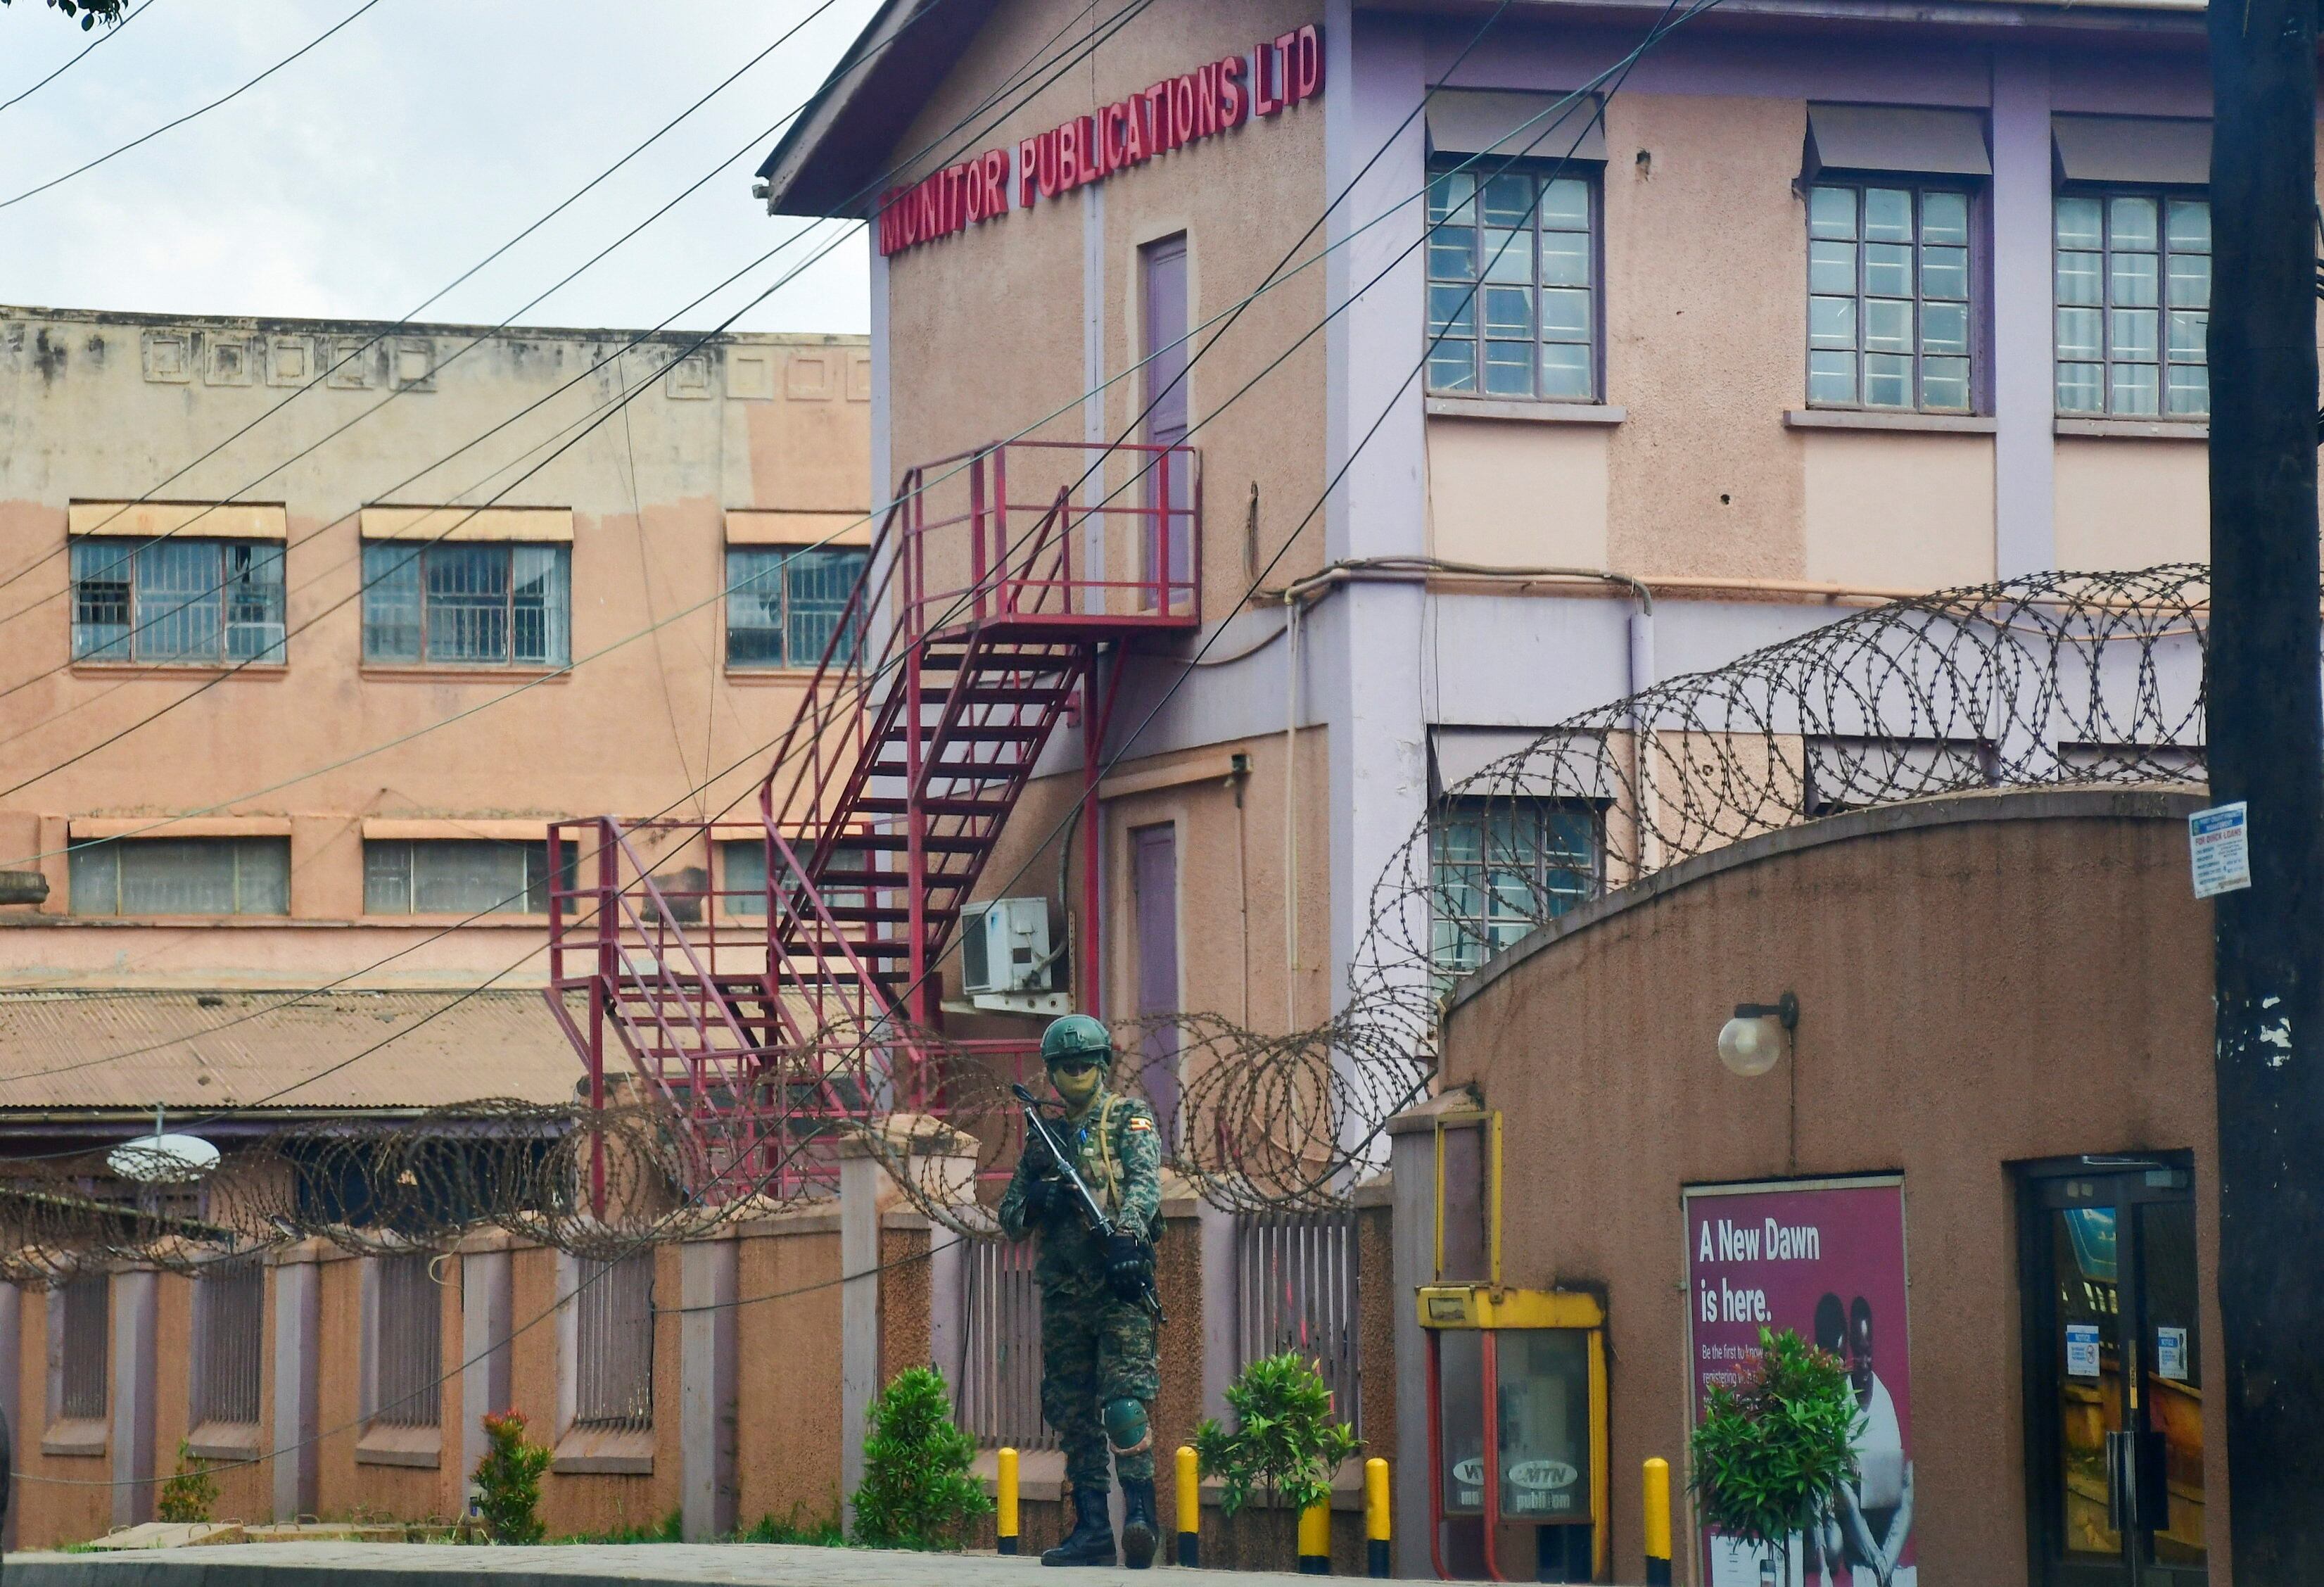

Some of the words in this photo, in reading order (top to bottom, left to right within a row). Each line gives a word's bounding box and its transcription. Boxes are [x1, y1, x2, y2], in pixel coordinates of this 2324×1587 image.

[880, 148, 1009, 256] MONITOR
[1020, 56, 1247, 208] PUBLICATIONS
[1255, 23, 1326, 116] LTD
[1699, 1220, 1714, 1262] A
[1718, 1220, 1759, 1261] New
[1765, 1218, 1820, 1260] Dawn
[1701, 1279, 1717, 1322] is
[1722, 1277, 1771, 1322] here.
[1703, 1344, 1710, 1359] Be
[1712, 1343, 1722, 1359] the
[1723, 1343, 1736, 1359] first
[1738, 1346, 1745, 1359] to
[1525, 1467, 1566, 1483] MTN
